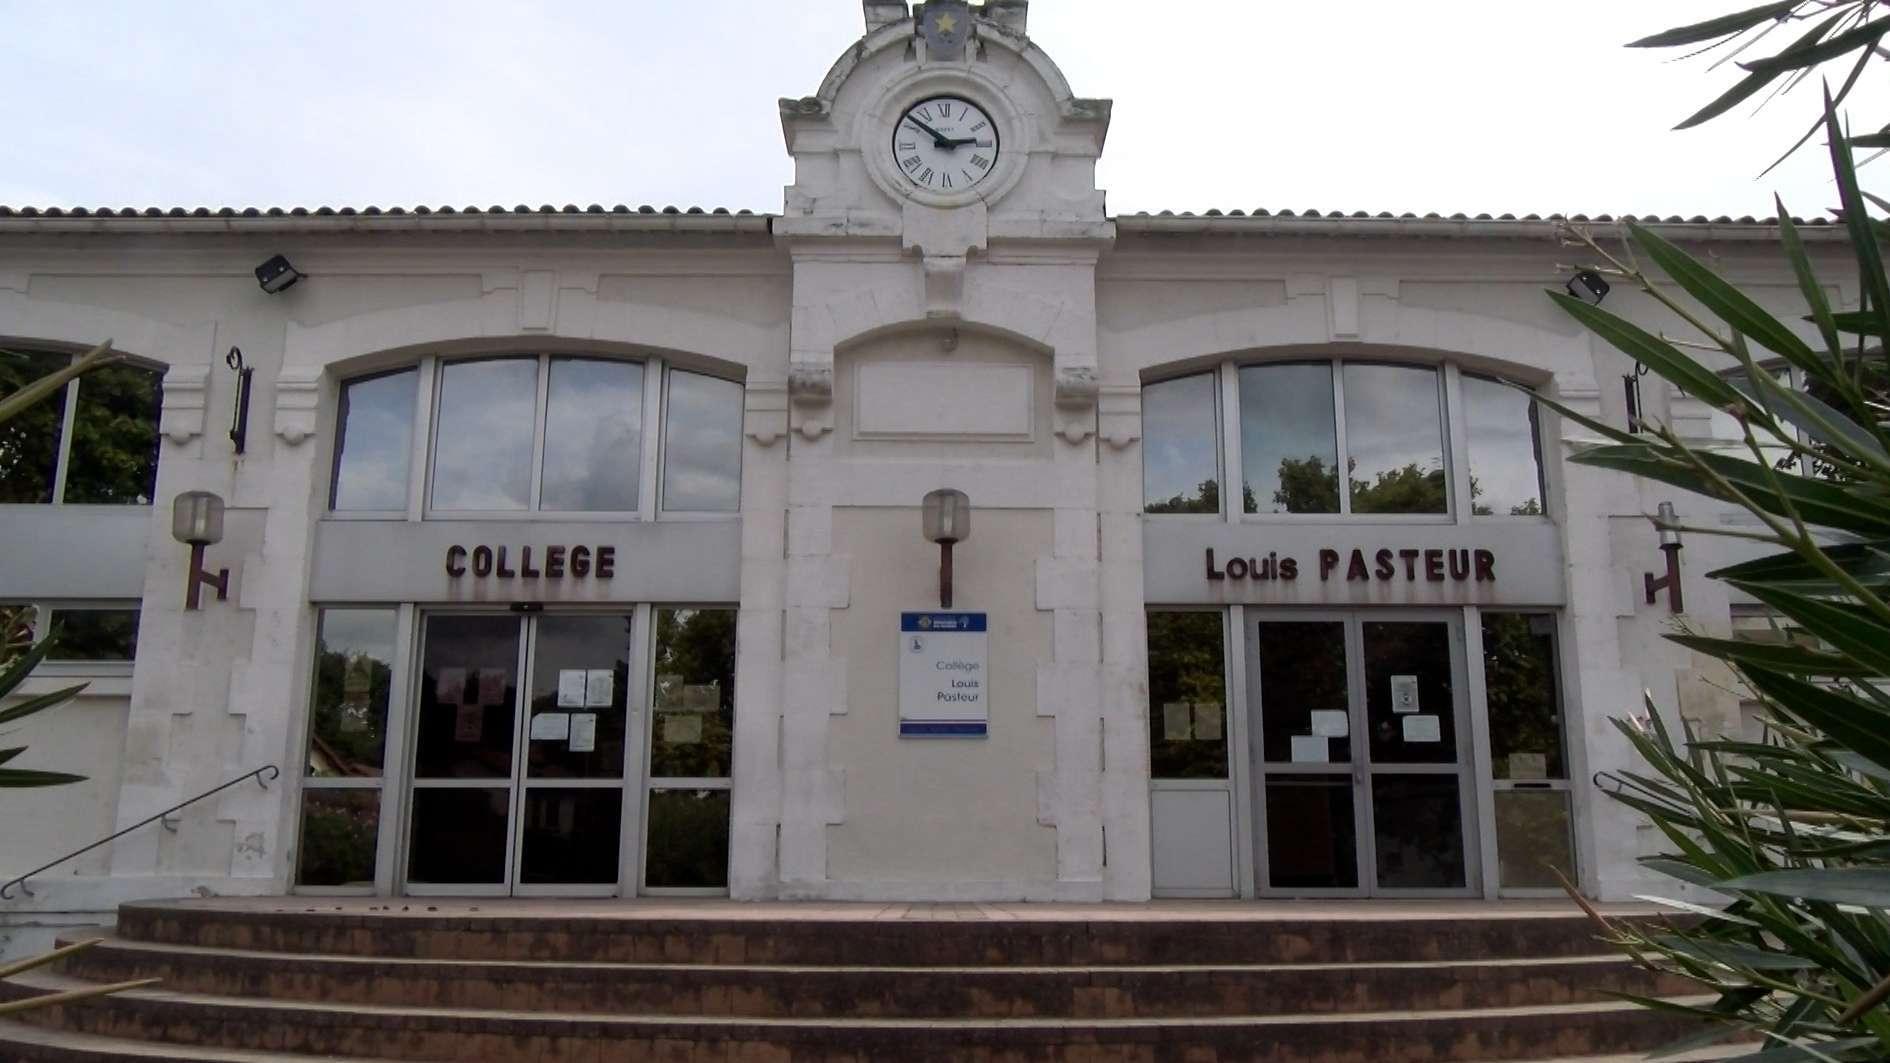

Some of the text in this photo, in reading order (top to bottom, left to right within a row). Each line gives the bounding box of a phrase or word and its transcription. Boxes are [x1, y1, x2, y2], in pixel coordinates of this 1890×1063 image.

[446, 545, 615, 578] COLLEGE
[1206, 547, 1496, 582] Louis PASTEUR
[951, 678, 980, 688] Louis
[937, 691, 979, 702] Pasteur
